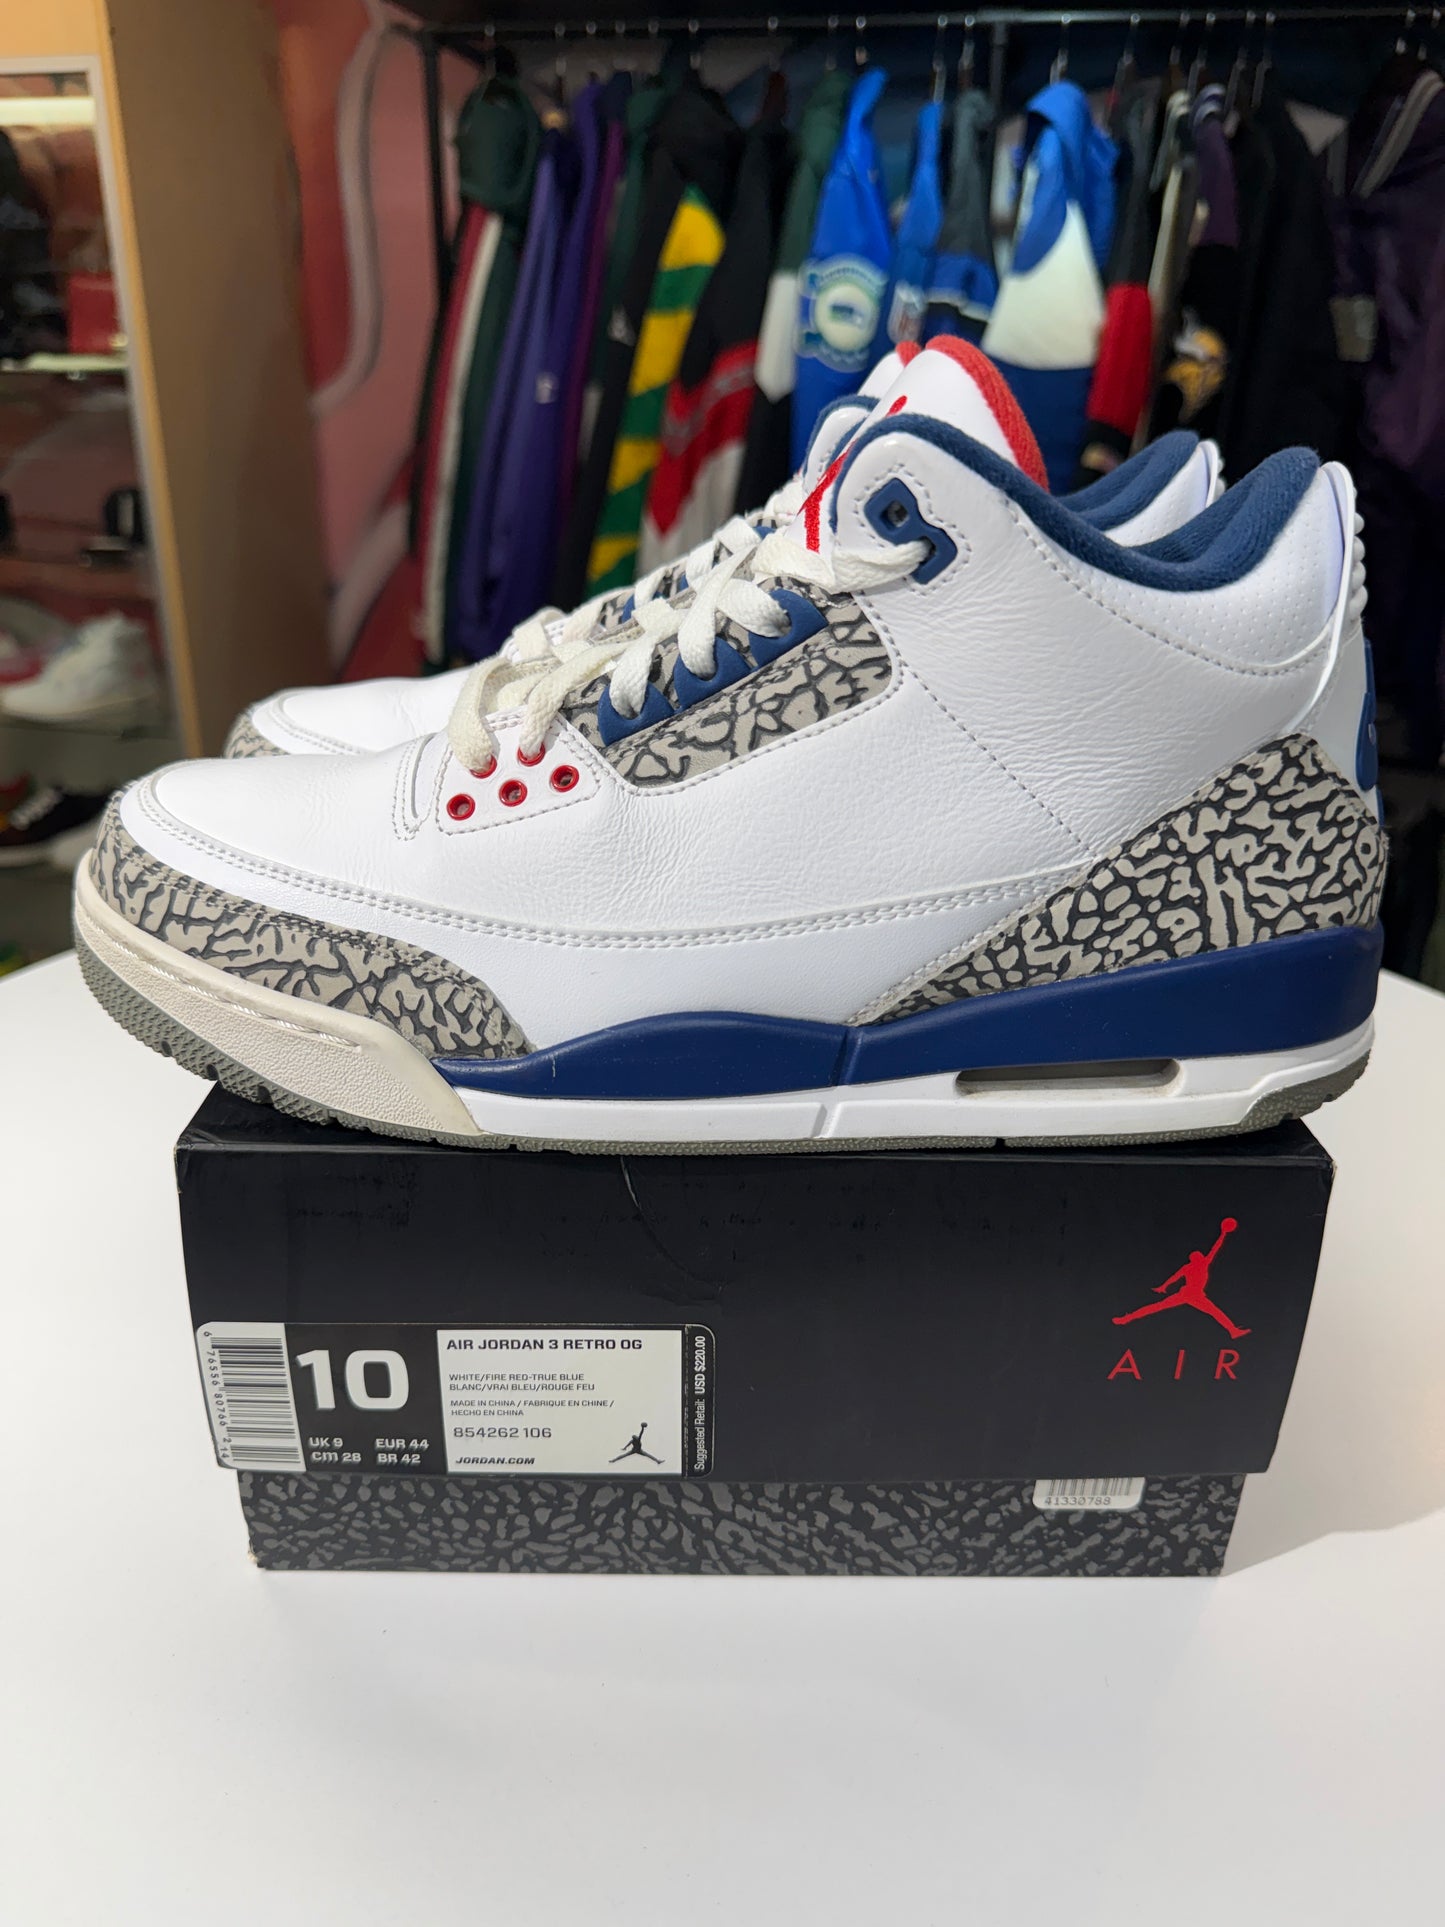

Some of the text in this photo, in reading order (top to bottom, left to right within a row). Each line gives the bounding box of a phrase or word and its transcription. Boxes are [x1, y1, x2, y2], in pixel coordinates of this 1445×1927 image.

[447, 1339, 643, 1350] AIR JORDAN 3 RETRO OG
[1107, 1349, 1240, 1380] AIR
[296, 1349, 410, 1411] 10
[449, 1373, 585, 1381] WHITE/FIRE RED-TRUE BLUE
[206, 1351, 220, 1386] 76556
[214, 1393, 228, 1426] 80766
[449, 1383, 595, 1392] BLANC/VRAI BLEU/ROUGE FEU
[694, 1336, 708, 1470] Suggested Retail: USD $220.00
[453, 1427, 552, 1438] 854262 106
[309, 1437, 344, 1448] UK 9
[375, 1438, 430, 1450] EUR 44
[342, 1452, 362, 1463] 28
[378, 1453, 421, 1464] BR 42
[455, 1456, 535, 1465] JORDAN.COM
